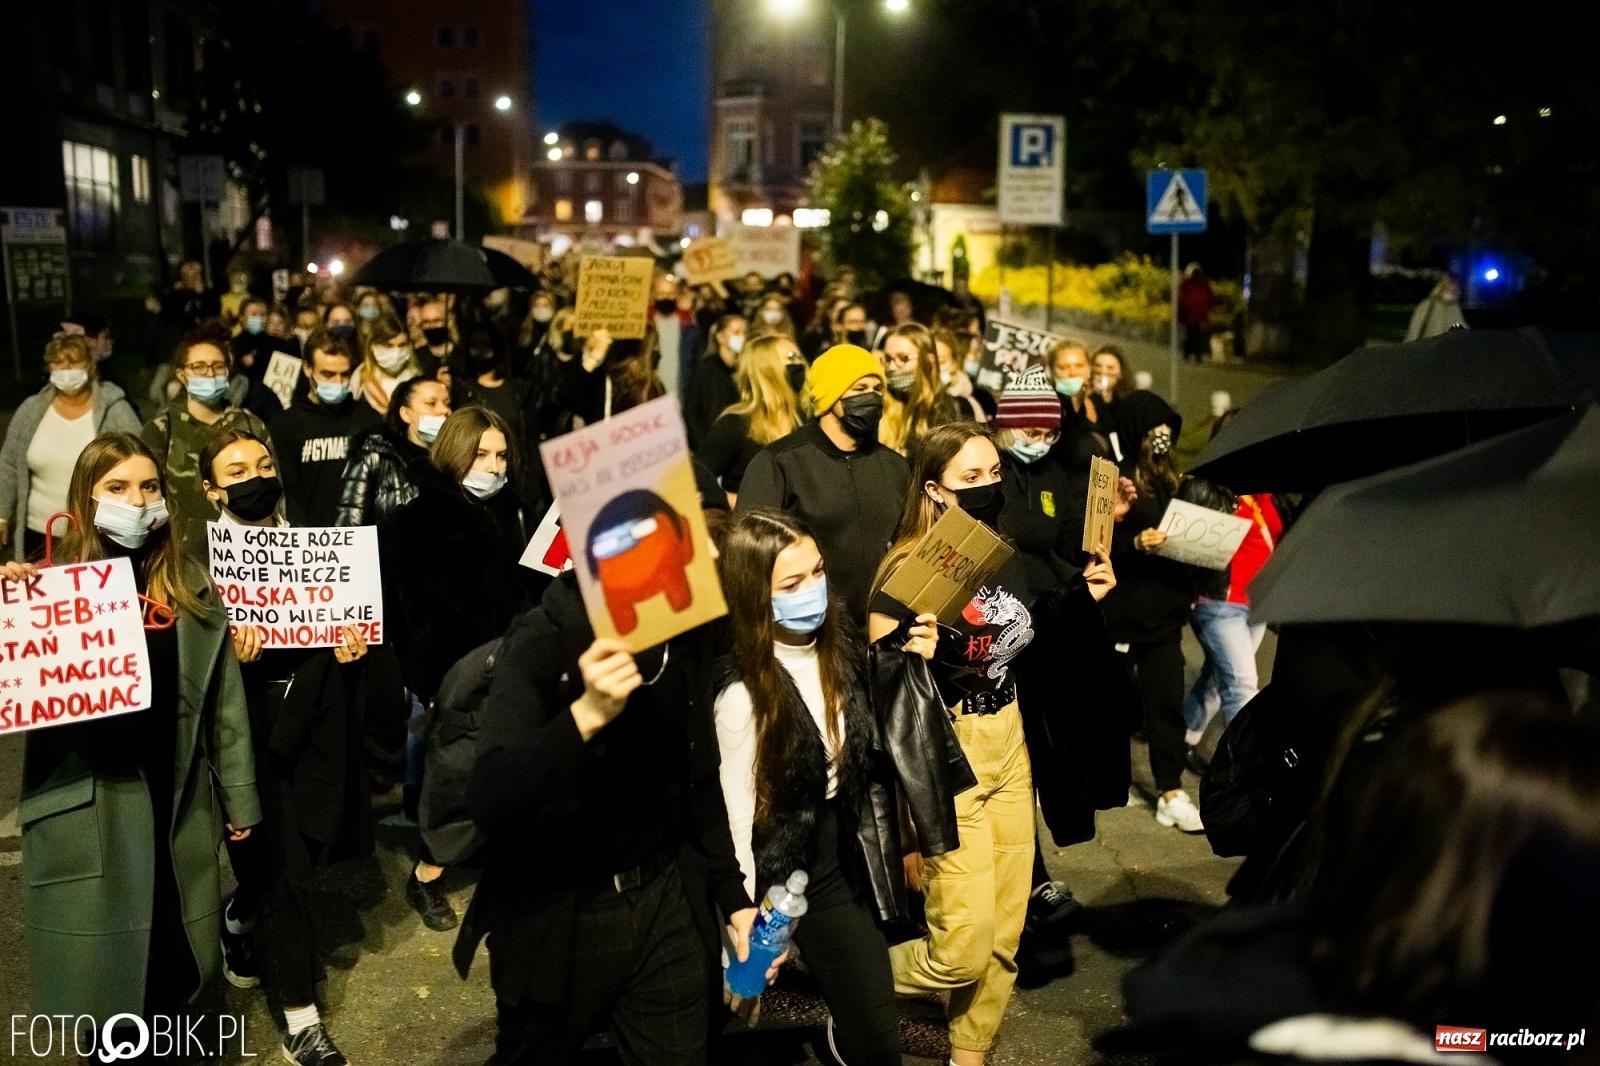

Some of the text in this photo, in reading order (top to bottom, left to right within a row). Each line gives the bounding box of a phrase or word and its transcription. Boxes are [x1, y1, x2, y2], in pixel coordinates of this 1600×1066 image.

[1020, 128, 1046, 163] P
[211, 527, 355, 548] NA GÓRZE RÓŻE
[1165, 511, 1242, 554] DOŚĆ
[213, 547, 340, 566] NA DOLE DWA
[64, 564, 113, 592] TY
[214, 566, 351, 583] NAGIE MIECZE
[217, 584, 334, 608] POLSKA TO
[227, 605, 373, 624] EDNO WIELKIE
[0, 627, 115, 664] TAŃ MI
[40, 652, 138, 688] MACICĘ
